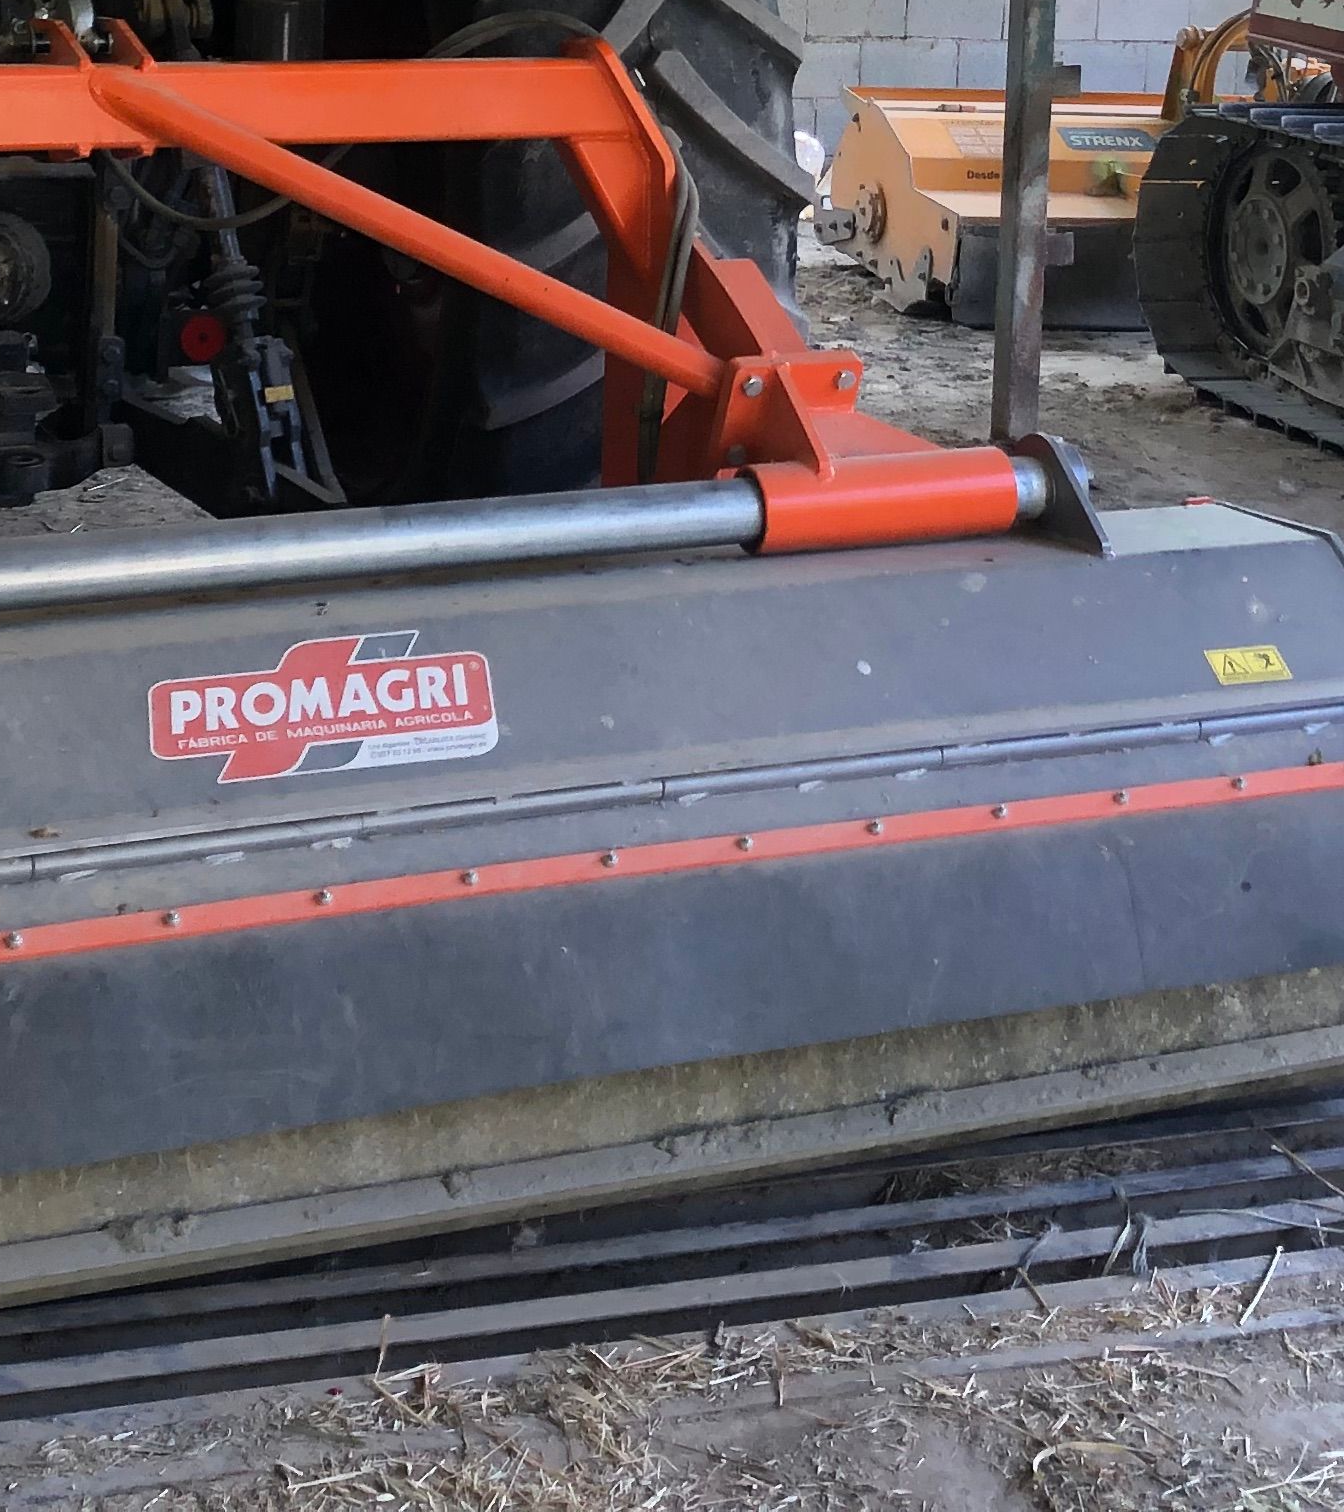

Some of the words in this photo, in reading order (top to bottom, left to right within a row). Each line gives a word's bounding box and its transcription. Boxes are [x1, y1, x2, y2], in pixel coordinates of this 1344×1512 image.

[1069, 135, 1144, 147] STRENX
[966, 169, 1001, 180] Desde
[170, 663, 469, 736] PROMAGRI
[255, 729, 279, 743] DE
[286, 719, 388, 739] MAQUINARIA
